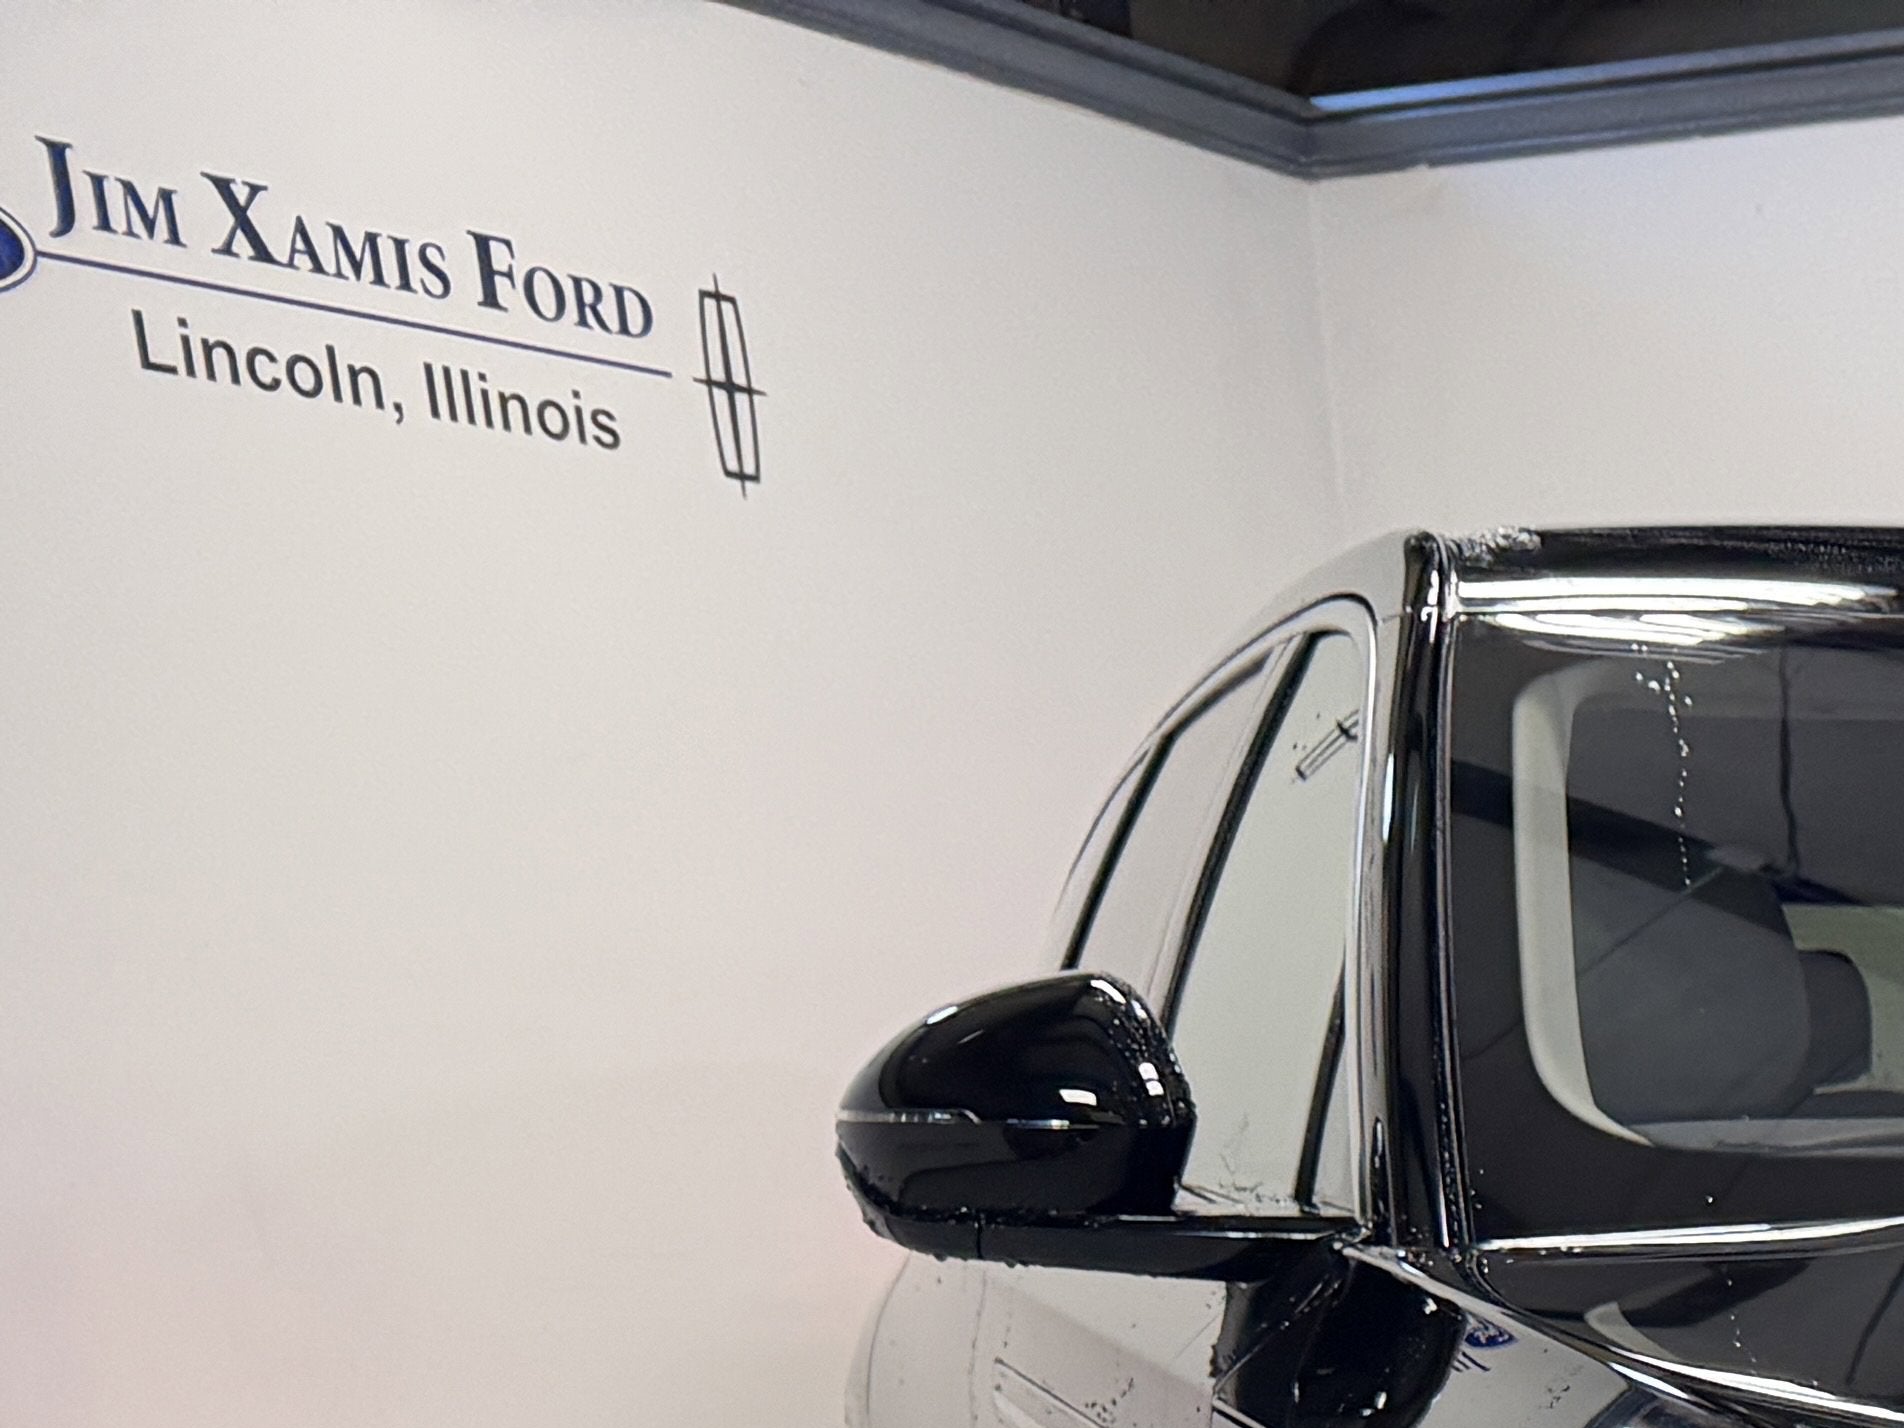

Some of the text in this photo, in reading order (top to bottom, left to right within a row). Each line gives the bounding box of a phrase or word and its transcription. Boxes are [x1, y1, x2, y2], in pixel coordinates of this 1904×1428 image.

[466, 230, 654, 338] FORD
[131, 309, 622, 450] Lincoln, Illinois
